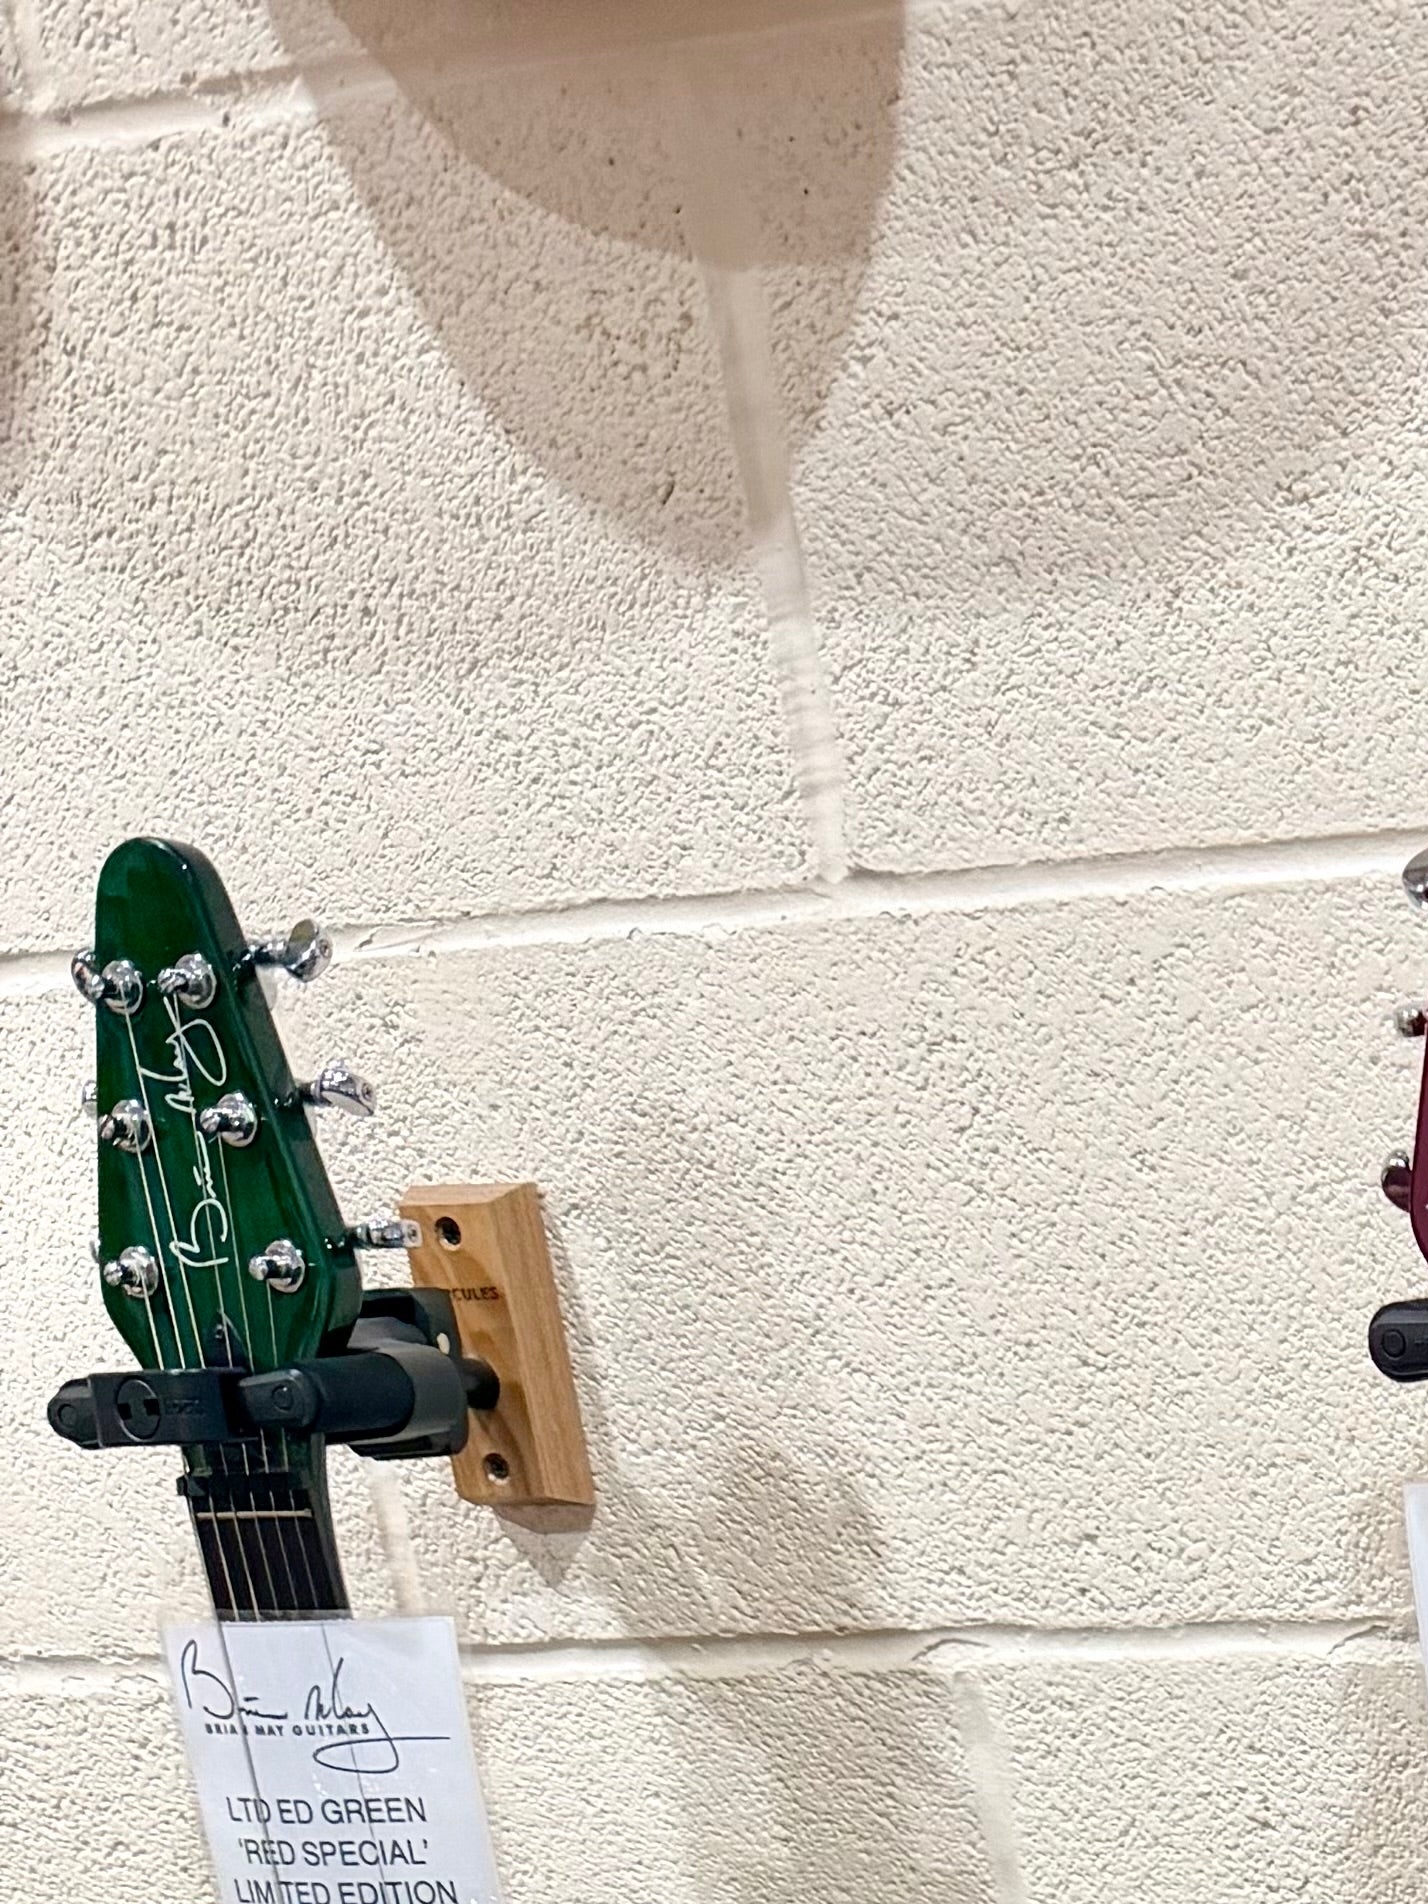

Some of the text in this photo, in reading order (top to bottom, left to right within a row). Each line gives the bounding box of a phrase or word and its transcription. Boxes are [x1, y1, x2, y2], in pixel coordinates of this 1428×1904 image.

[254, 1724, 284, 1737] MAY
[292, 1723, 370, 1736] GUITARS
[226, 1796, 428, 1825] LTD ED GREEN
